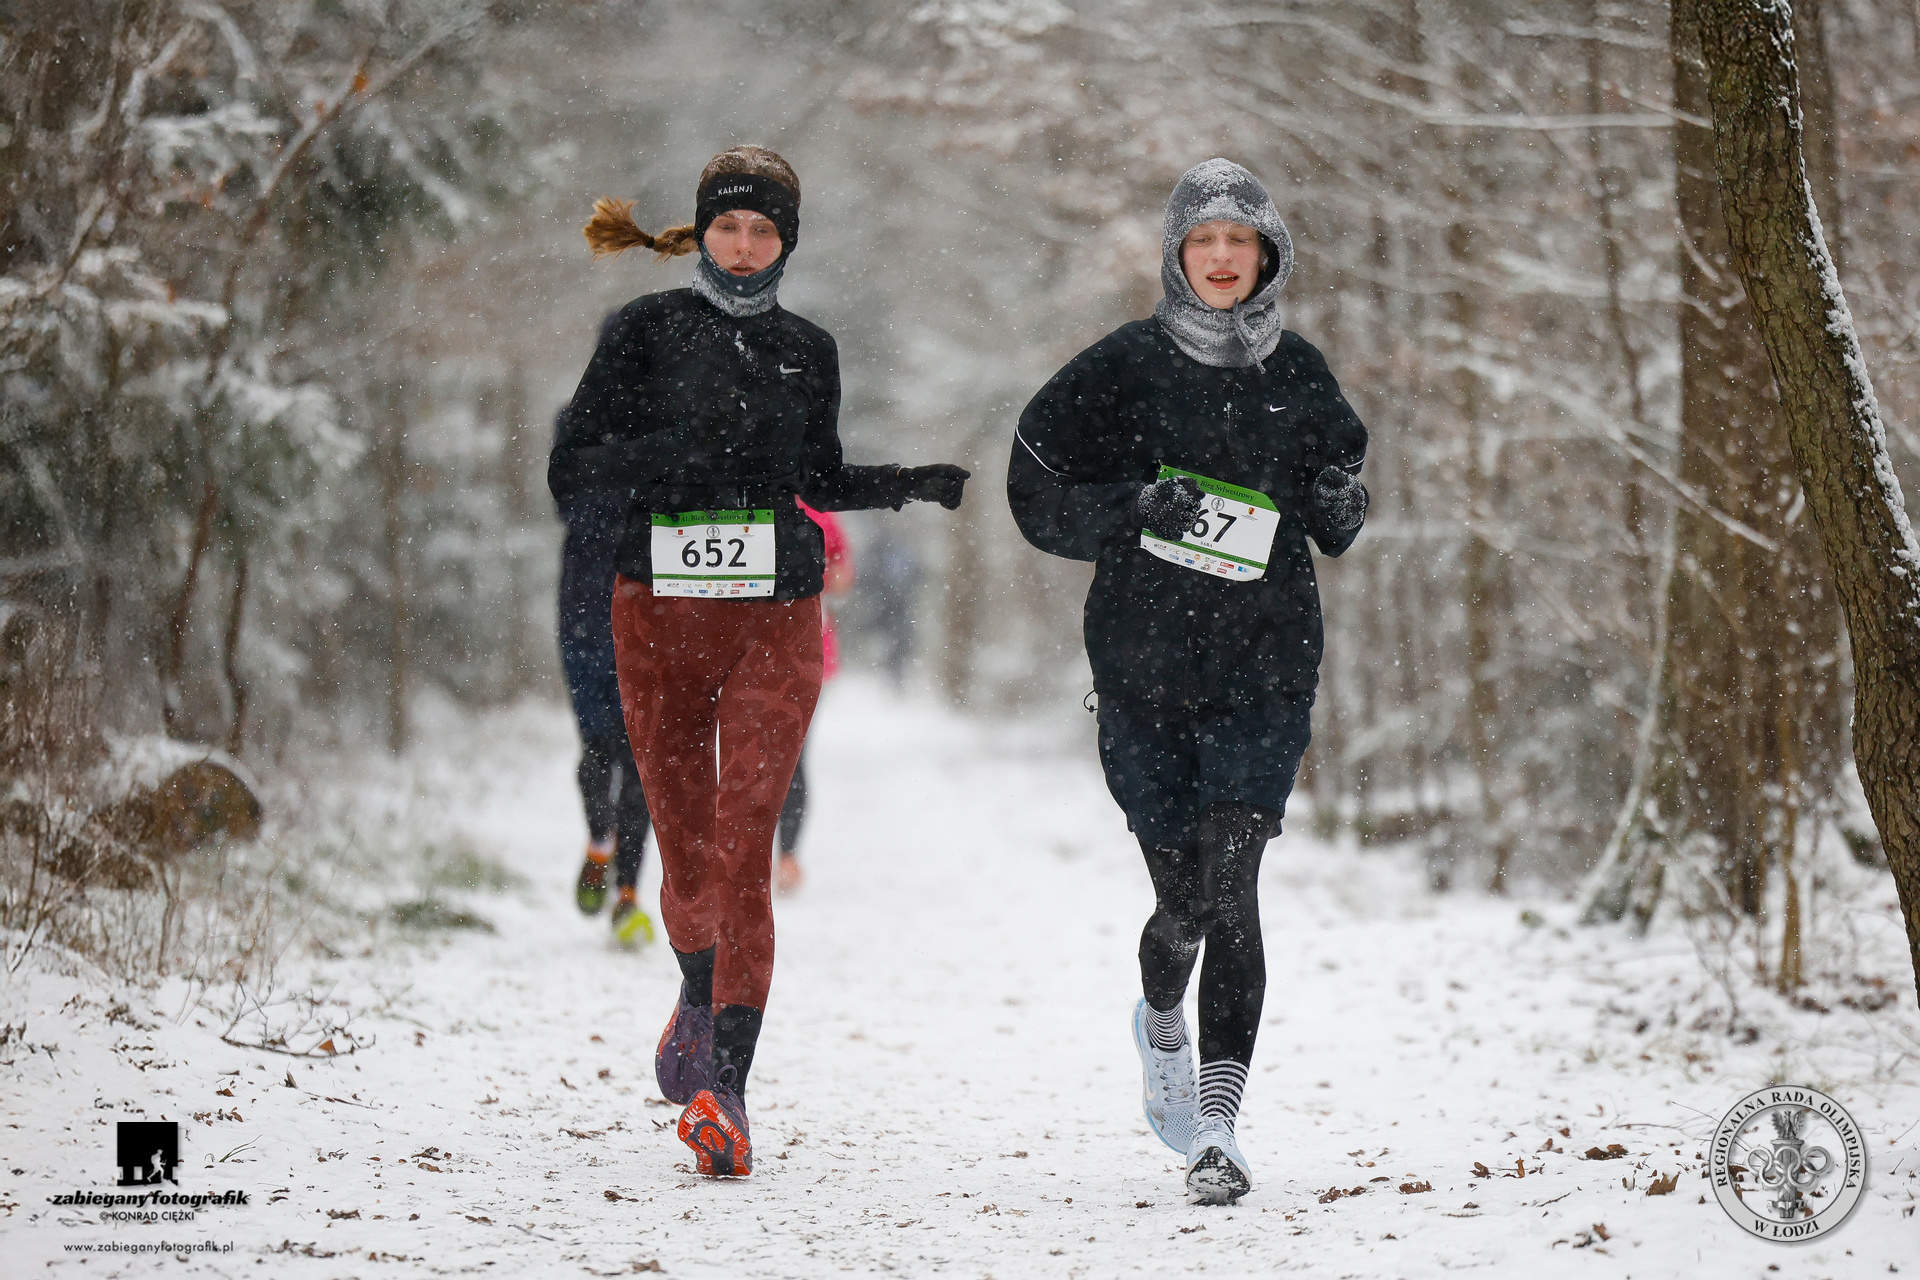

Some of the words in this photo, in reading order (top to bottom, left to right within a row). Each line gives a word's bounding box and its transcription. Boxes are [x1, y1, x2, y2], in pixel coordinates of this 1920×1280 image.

[718, 185, 753, 196] KALENJI
[1190, 508, 1238, 543] 67
[681, 538, 747, 568] 652
